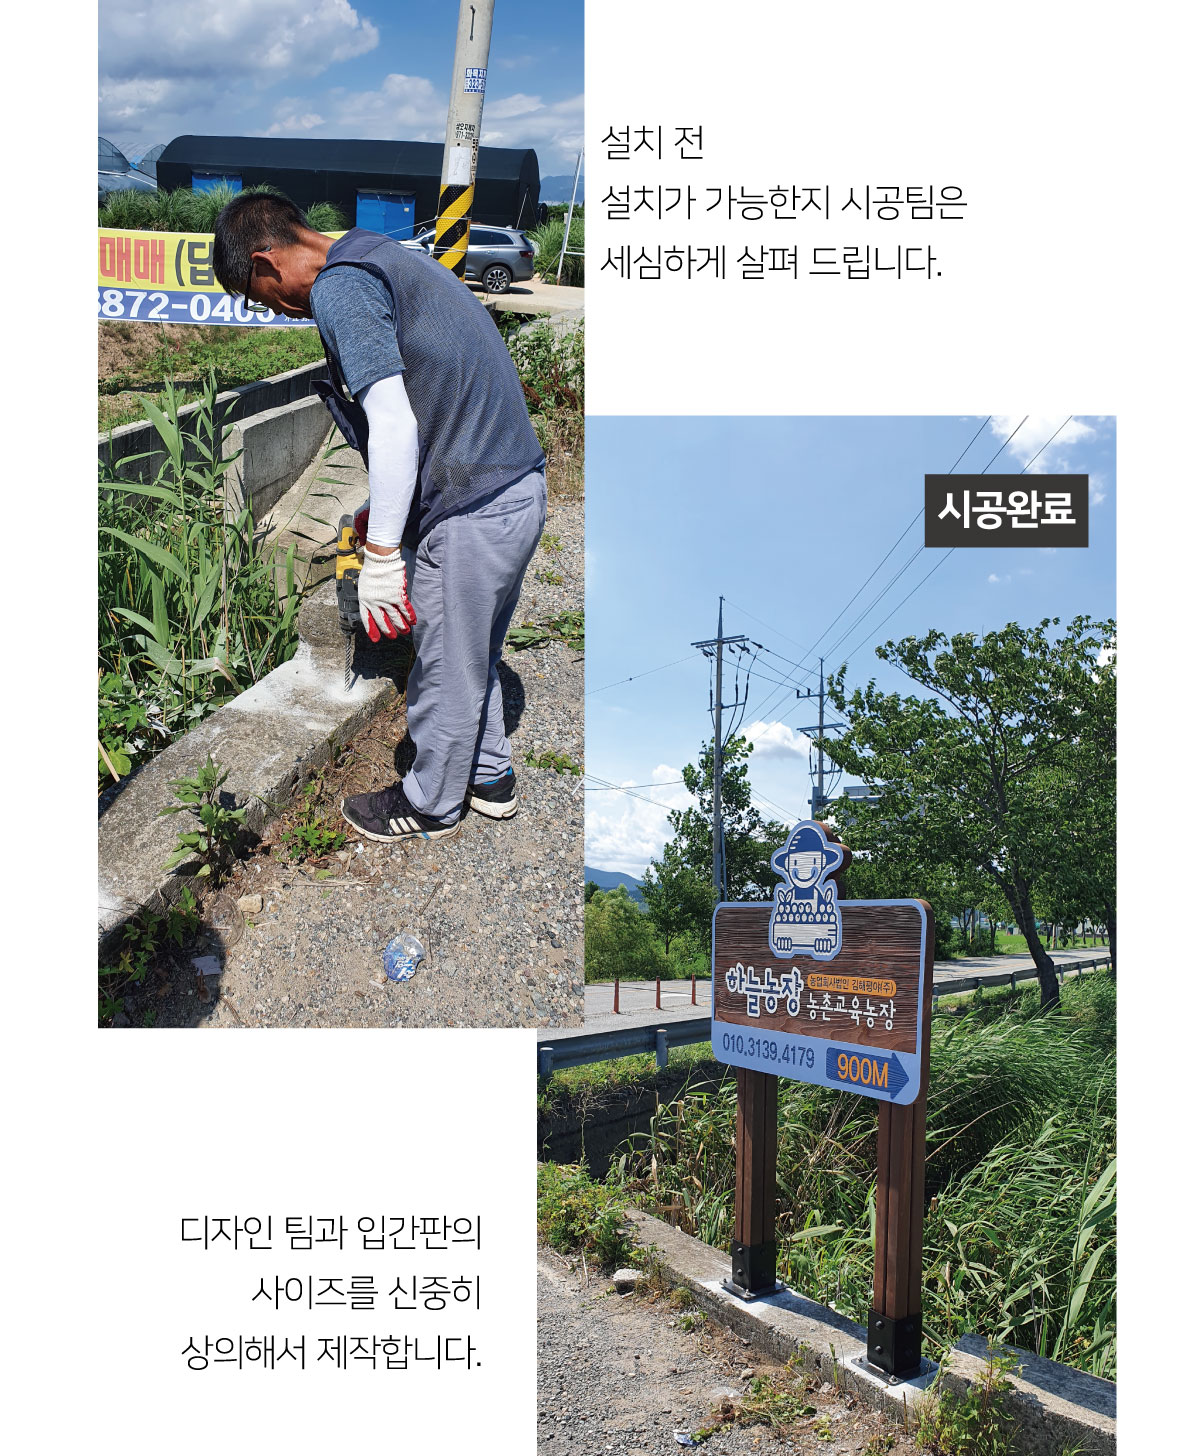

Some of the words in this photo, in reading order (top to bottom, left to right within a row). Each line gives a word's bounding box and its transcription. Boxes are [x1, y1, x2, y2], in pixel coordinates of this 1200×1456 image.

[99, 236, 166, 285] 매매
[725, 962, 805, 1018] 하늘농장
[806, 992, 896, 1031] 농촌교육농장
[723, 1032, 815, 1069] 010.3139.4179
[837, 1053, 889, 1089] 900M
